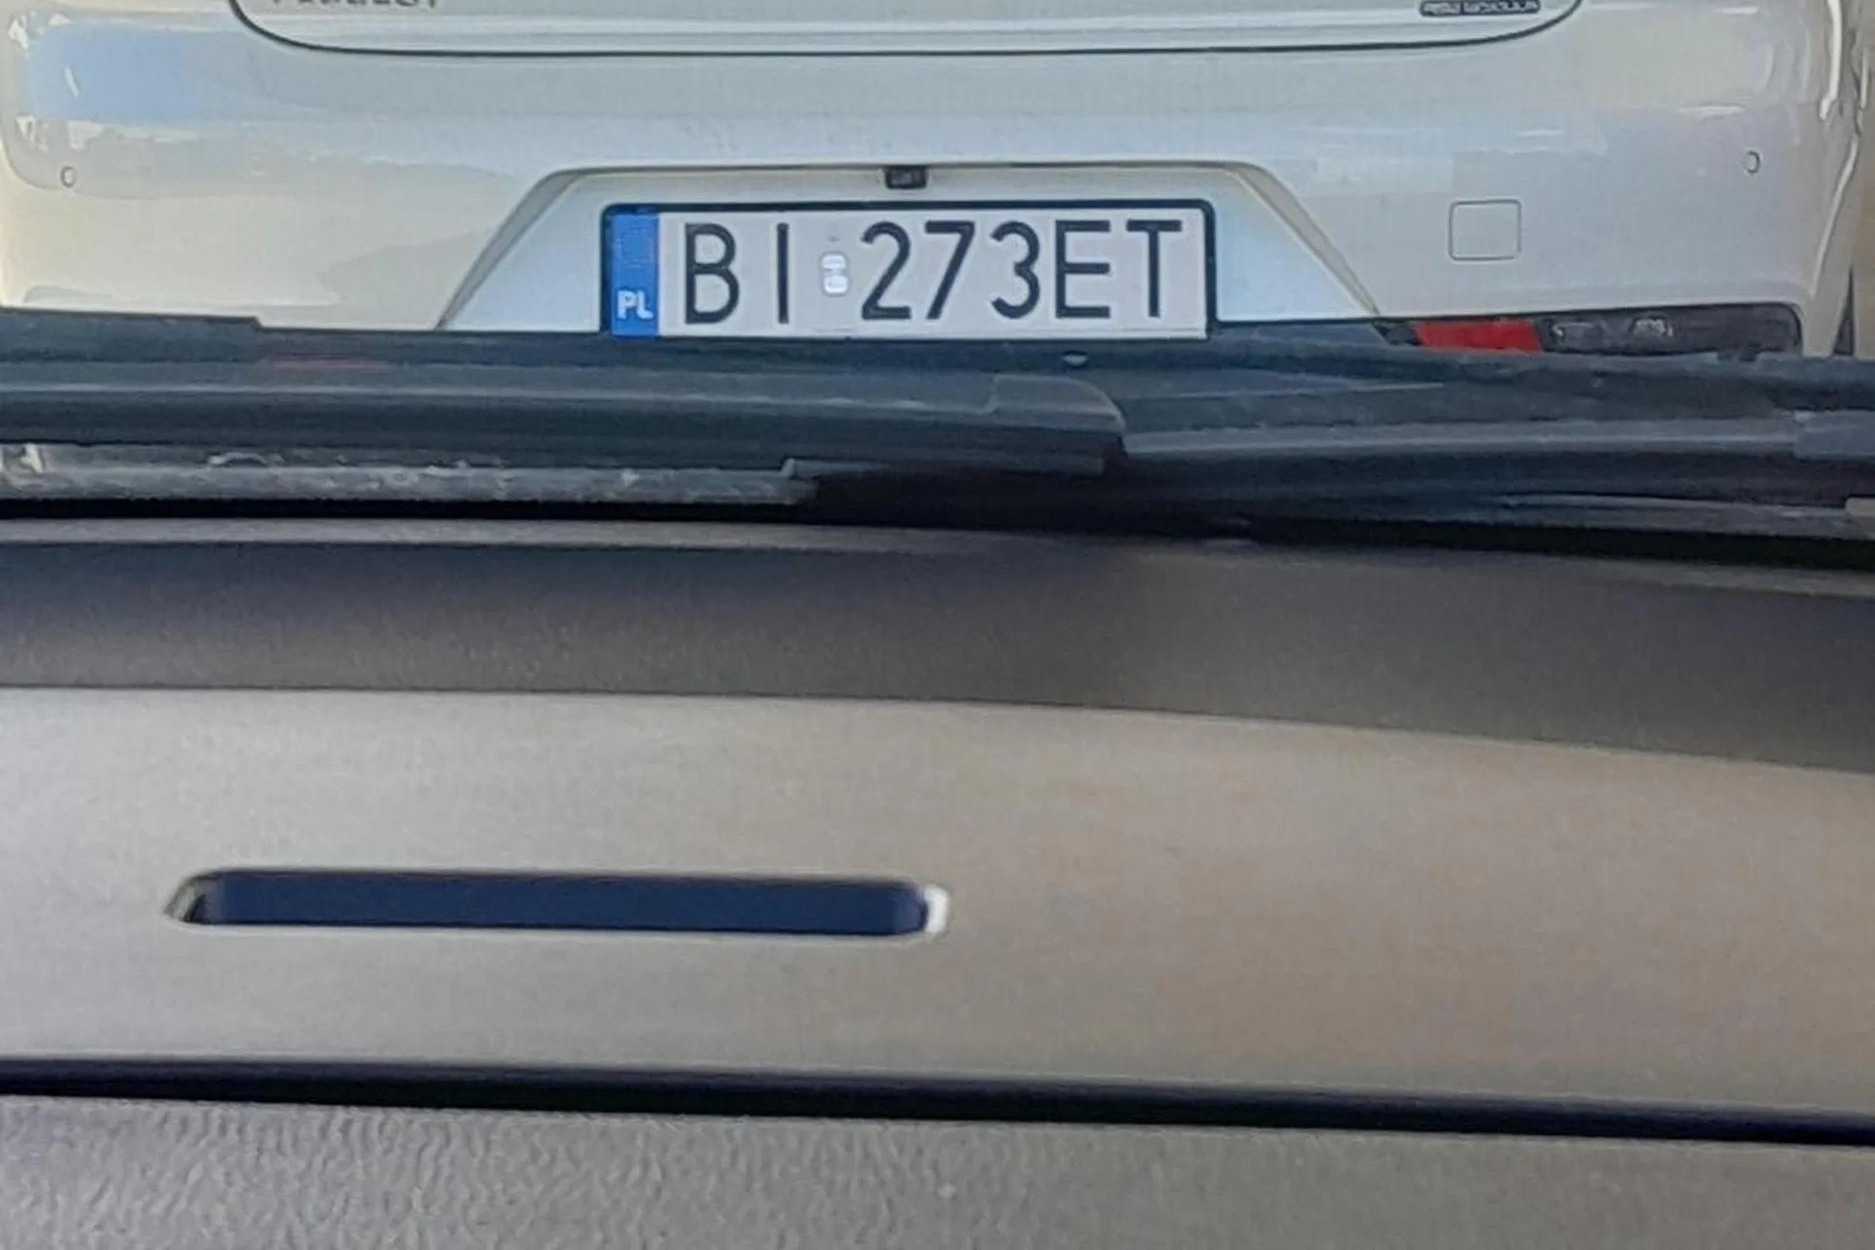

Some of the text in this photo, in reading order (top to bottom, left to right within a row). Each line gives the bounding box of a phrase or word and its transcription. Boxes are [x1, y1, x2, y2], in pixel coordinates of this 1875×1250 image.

[617, 290, 654, 318] PL
[684, 220, 1183, 325] BI 273ET
